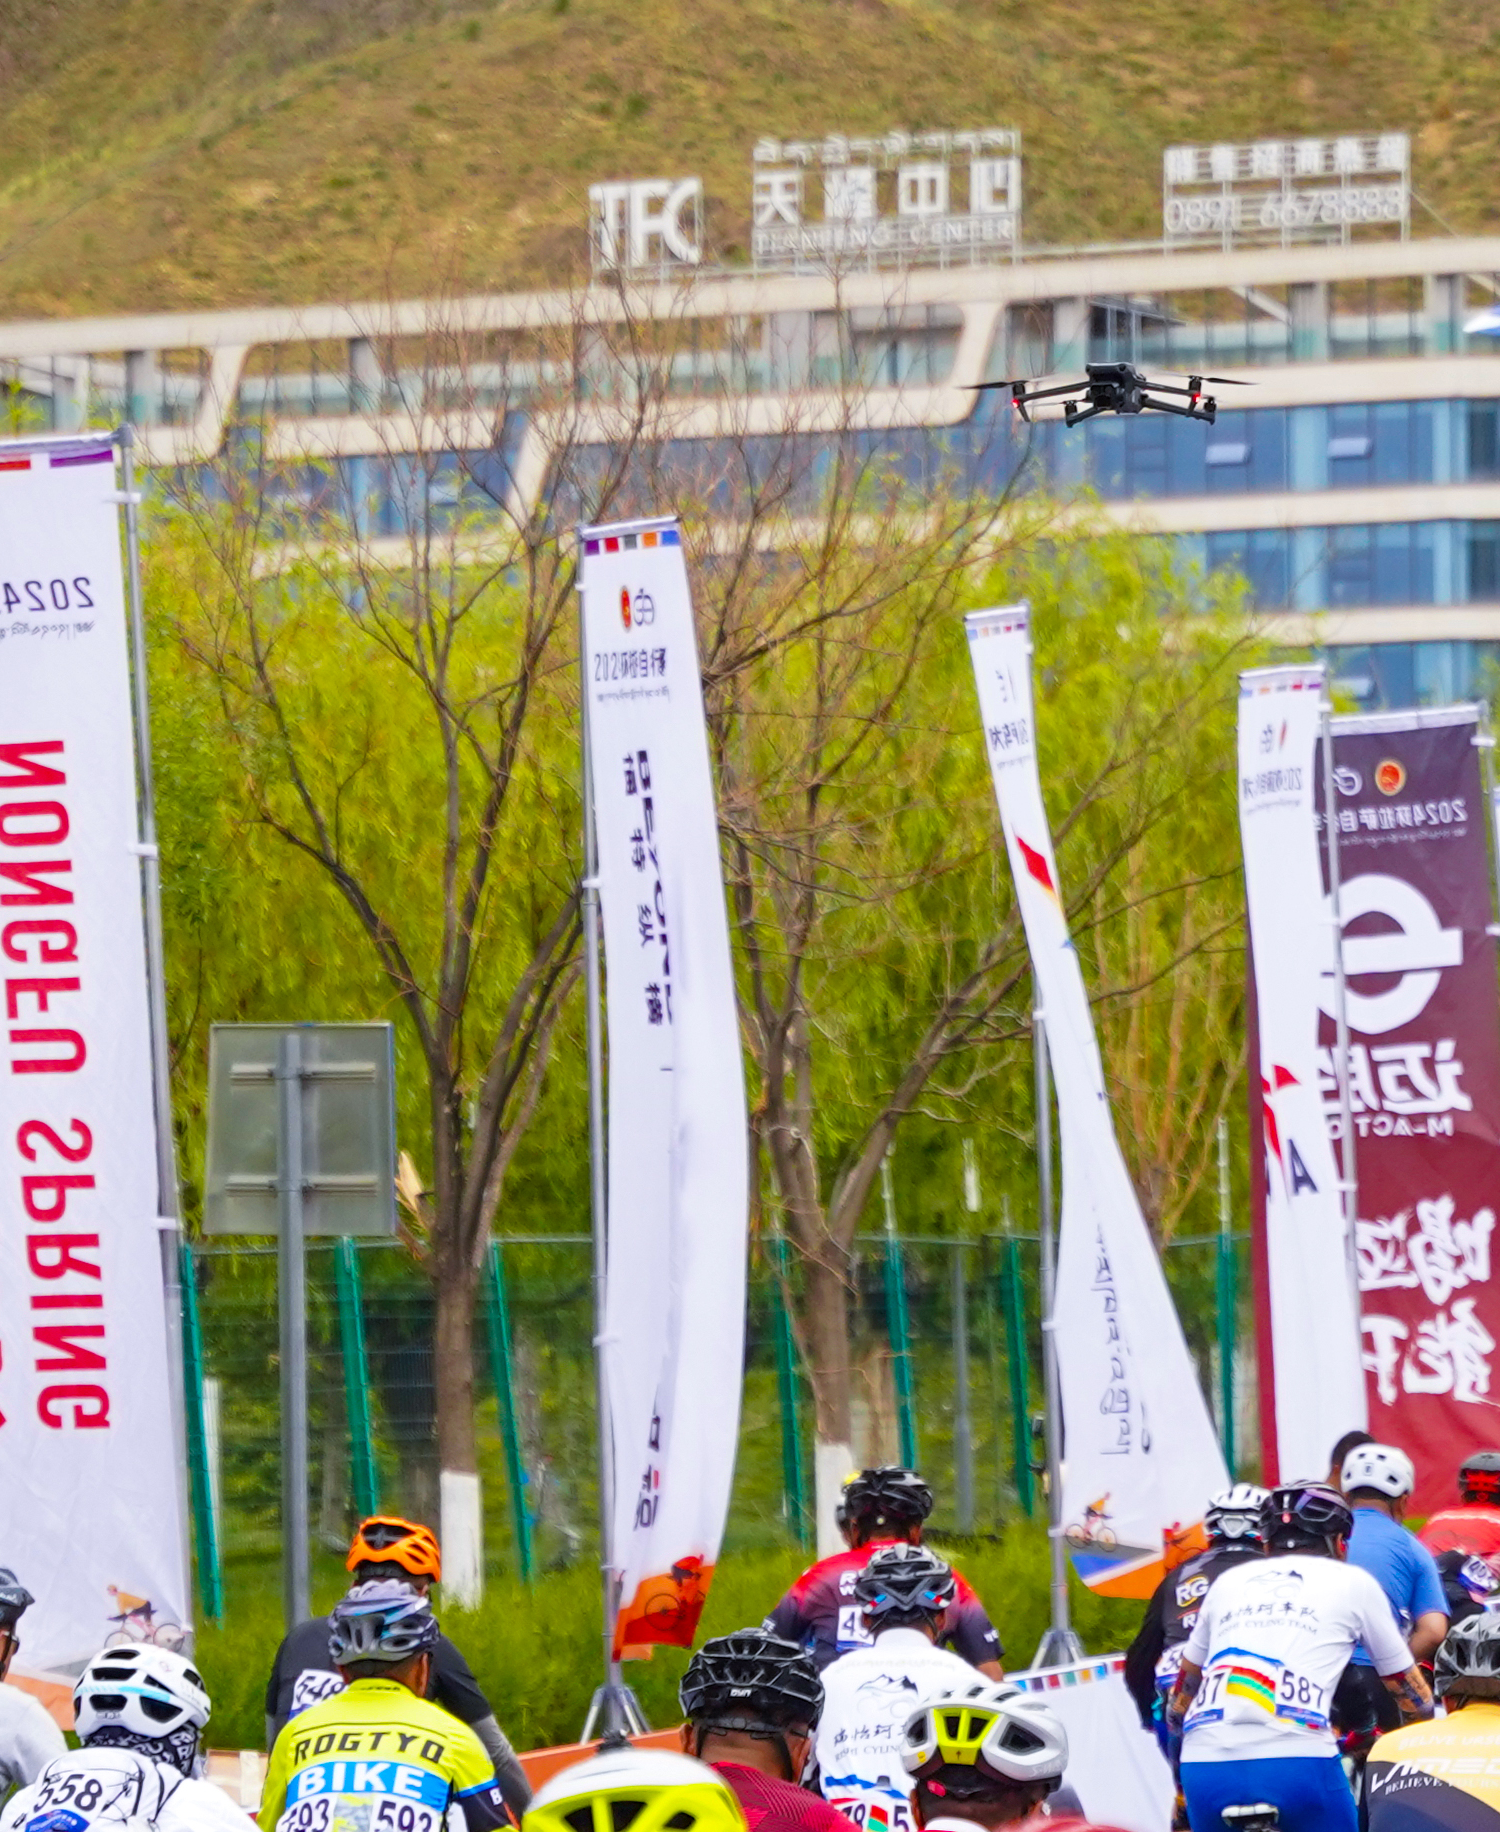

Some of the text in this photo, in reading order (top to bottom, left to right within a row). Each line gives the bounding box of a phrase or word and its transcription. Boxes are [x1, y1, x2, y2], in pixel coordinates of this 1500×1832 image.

[589, 177, 703, 268] TFC
[1280, 1668, 1324, 1709] 587
[293, 1731, 445, 1767] ROGTYO
[862, 1745, 903, 1756] CYLIN
[31, 1774, 104, 1812] 558
[297, 1762, 425, 1800] BIKE
[1384, 1776, 1444, 1796] BELIEVE
